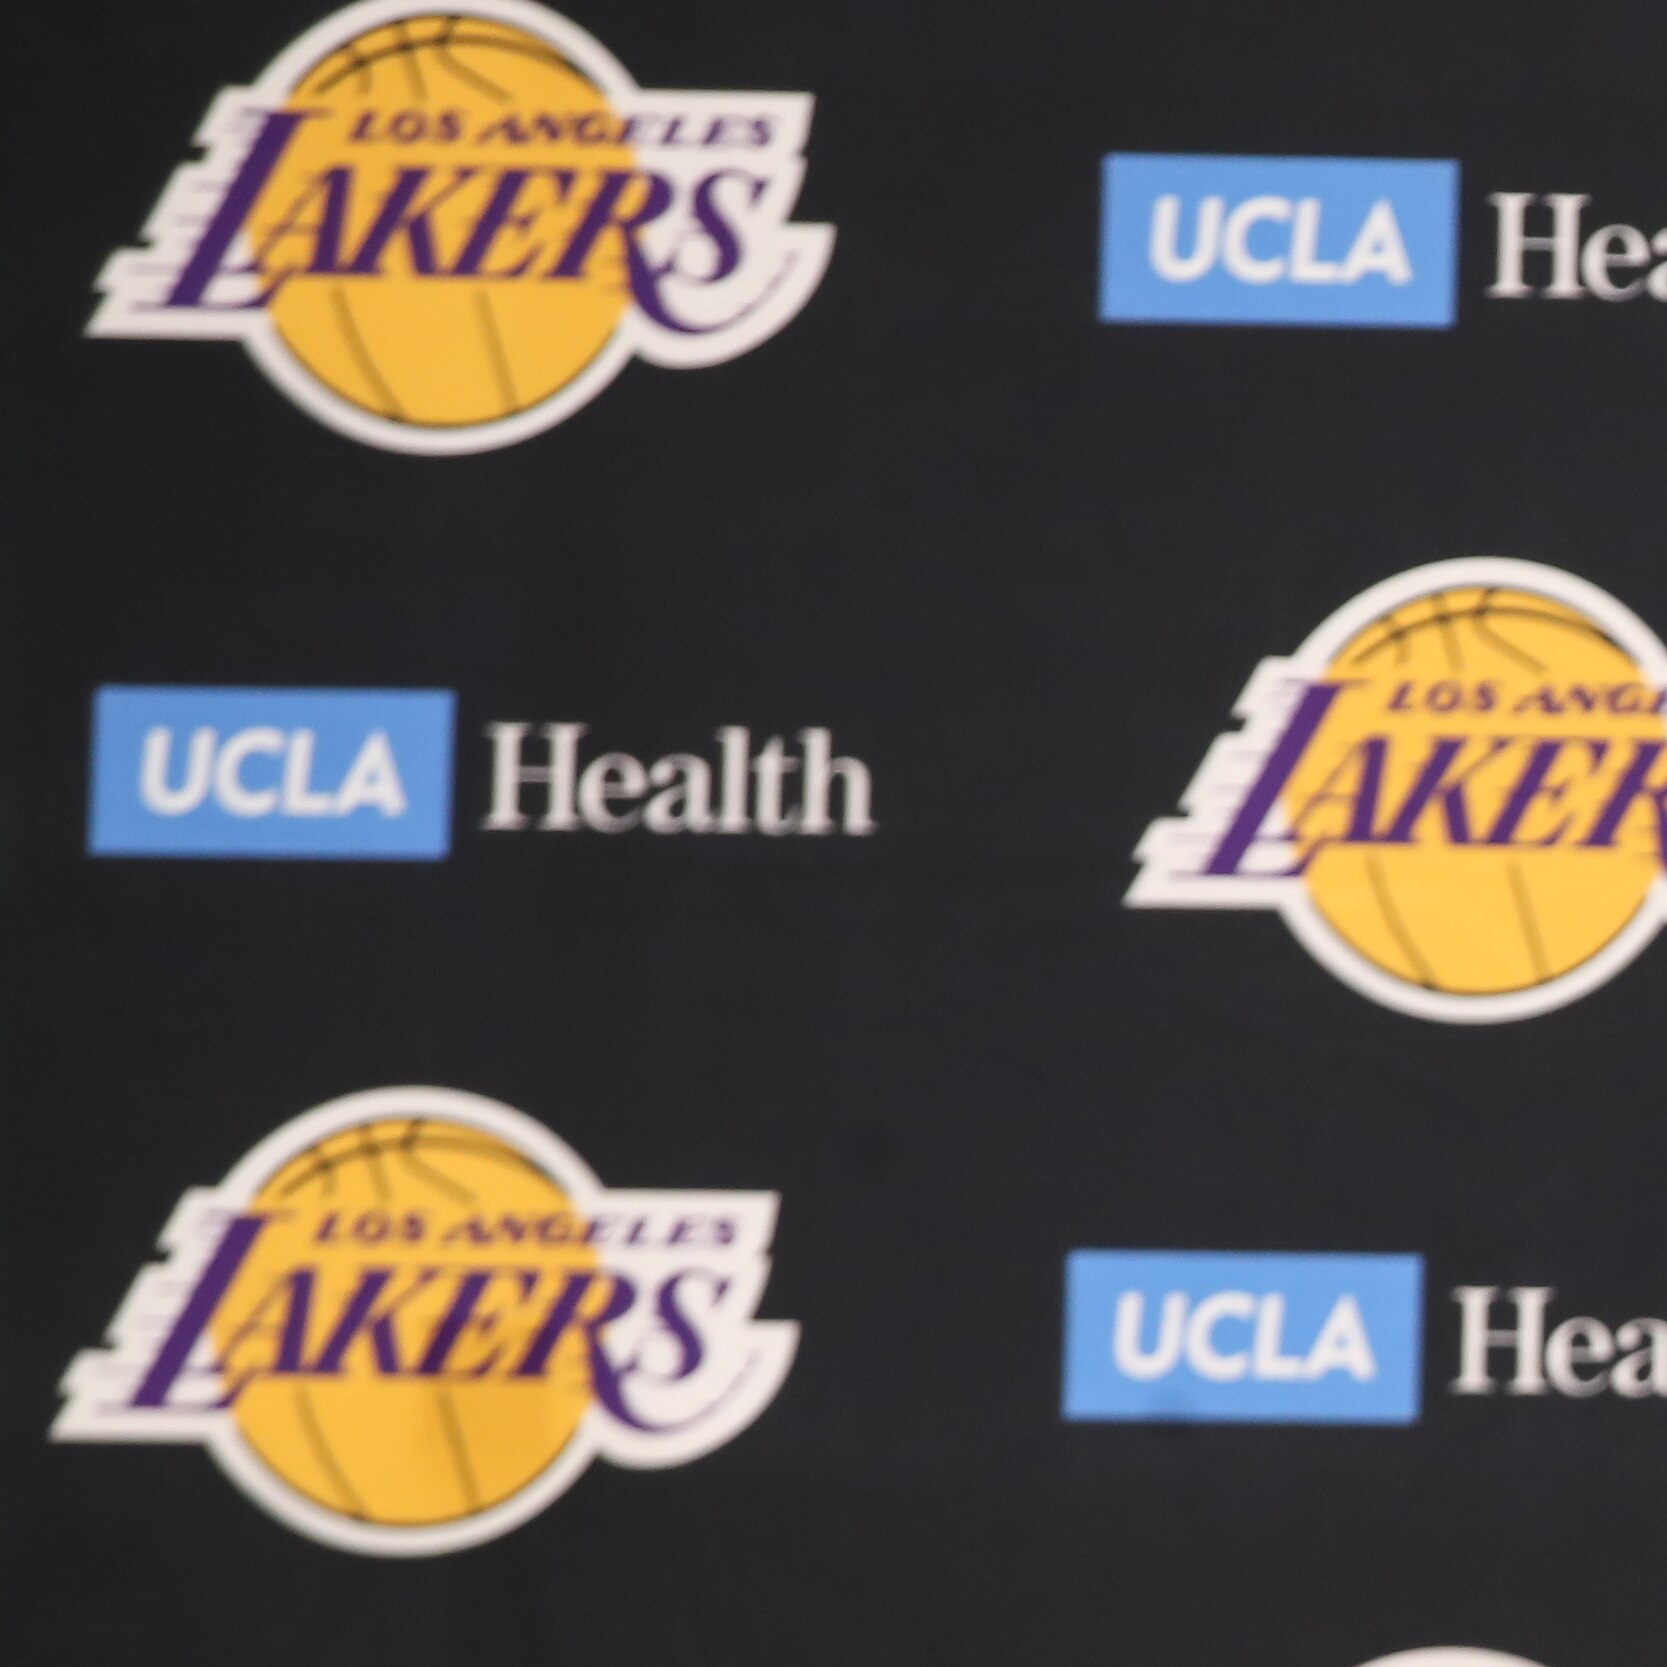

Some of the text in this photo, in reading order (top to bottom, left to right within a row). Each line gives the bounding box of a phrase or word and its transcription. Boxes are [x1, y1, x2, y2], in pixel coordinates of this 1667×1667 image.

[348, 110, 780, 148] LOS ANGELES
[141, 109, 798, 335] LAKERS
[1149, 194, 1414, 286] UCLA
[1386, 680, 1499, 714] LOS
[141, 722, 874, 835] UCLA Health
[313, 1210, 744, 1247] LOS ANGELES
[106, 1210, 761, 1434] LAKERS
[1112, 1290, 1377, 1383] UCLA
